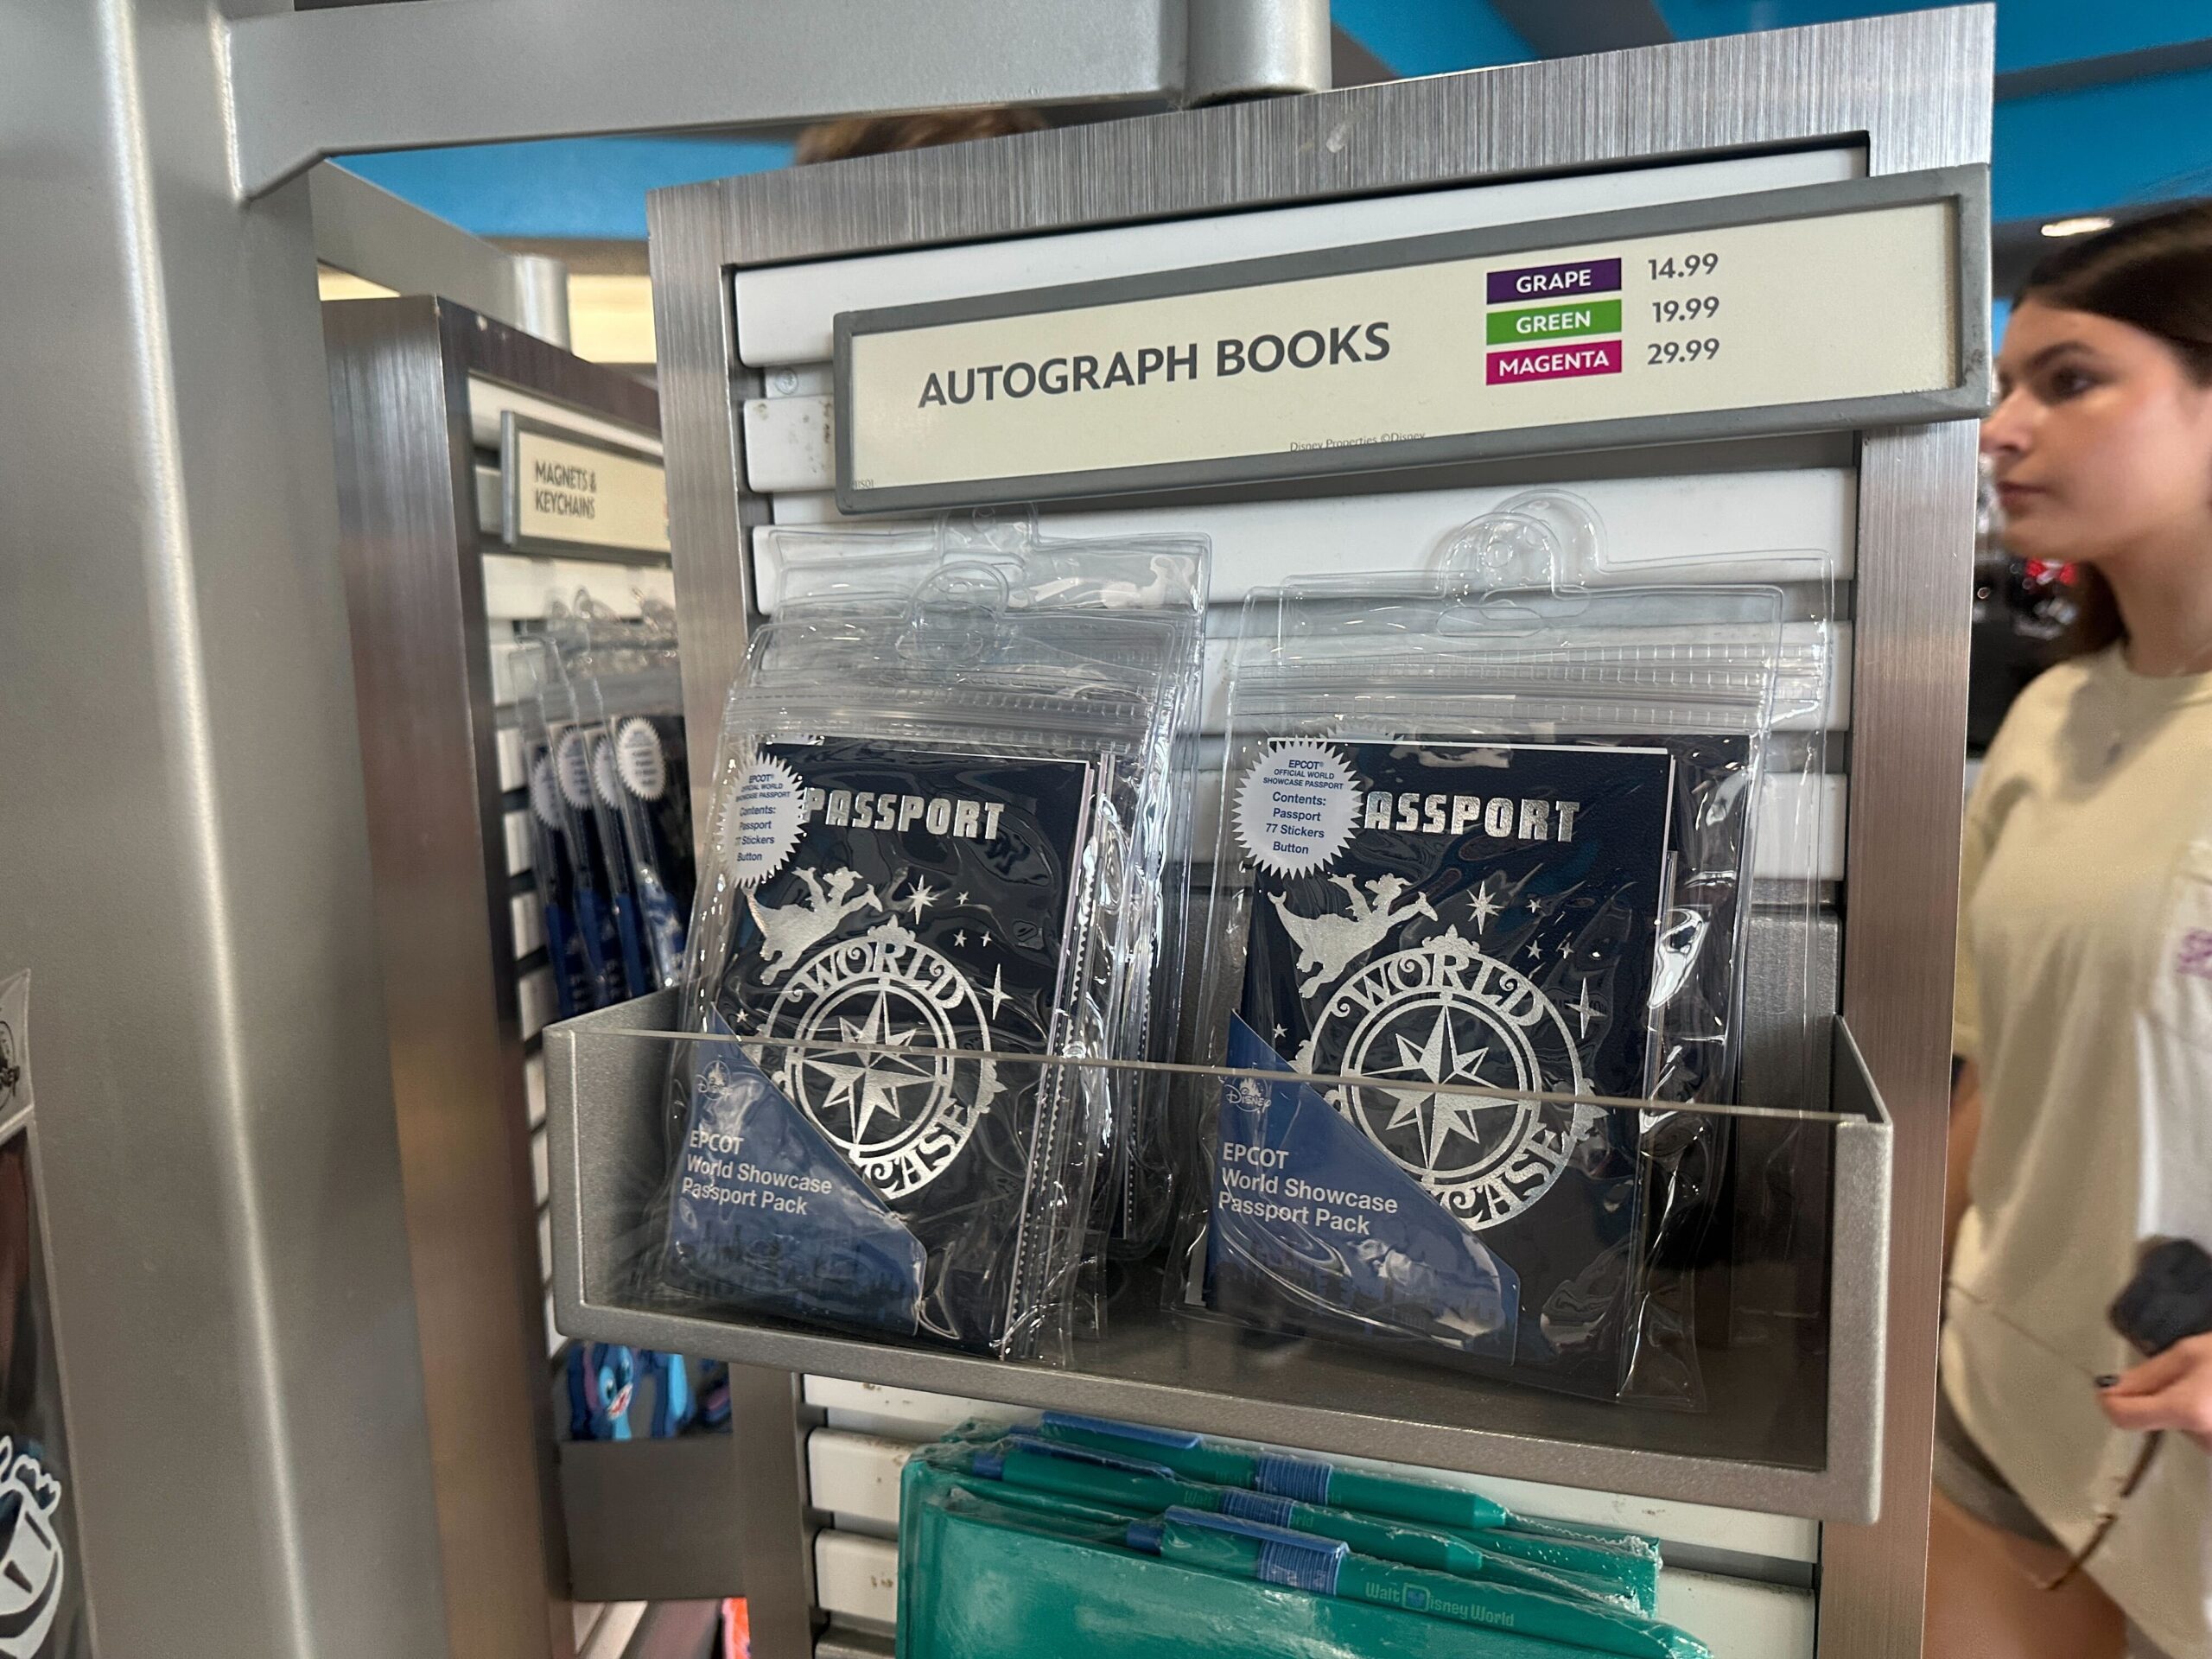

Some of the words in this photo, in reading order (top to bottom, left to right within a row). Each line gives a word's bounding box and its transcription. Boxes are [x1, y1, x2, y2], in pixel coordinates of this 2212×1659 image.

[1516, 269, 1592, 295] GRAPE
[1648, 253, 1719, 280] 14.99
[1515, 310, 1591, 334] GREEN
[1652, 296, 1719, 323] 19.99
[918, 343, 1198, 408] AUTOGRAPH
[1217, 321, 1389, 378] BOOKS
[1498, 350, 1610, 377] MAGENTA
[1647, 338, 1719, 365] 29.99
[1290, 442, 1322, 452] Disney
[1326, 438, 1377, 448] Properties
[535, 461, 588, 490] MAGNETS
[534, 489, 595, 519] KEYCHAINS
[1263, 778, 1303, 786] SHOWCASE
[1305, 780, 1344, 790] PASSPORT
[1274, 769, 1305, 778] OFFICIAL
[1307, 772, 1334, 780] WORLD
[740, 804, 776, 817] Contents:
[1273, 791, 1326, 805] Contents:
[740, 821, 772, 831] Passport
[801, 786, 1005, 840] PASSPORT
[1273, 808, 1321, 821] Passport
[1364, 791, 1580, 842] ASSPORT
[741, 836, 775, 845] Stickers
[1266, 823, 1278, 833] 77
[1281, 824, 1325, 838] Stickers
[737, 852, 762, 861] Button
[1273, 842, 1309, 855] Button
[791, 941, 964, 1010] WORLD
[1331, 951, 1545, 1027] WORLD
[690, 1130, 744, 1154] EPCOT
[1223, 1142, 1289, 1169] EPCOT
[687, 1154, 733, 1179] World
[737, 1163, 832, 1194] Showcase
[682, 1177, 757, 1205] Passport
[760, 1191, 808, 1215] Pack
[1222, 1167, 1278, 1194] World
[1284, 1178, 1398, 1213] Showcase
[1218, 1191, 1309, 1224] Passport
[1315, 1208, 1370, 1236] Pack
[1365, 1582, 1400, 1602] Walt
[1471, 1604, 1514, 1626] World
